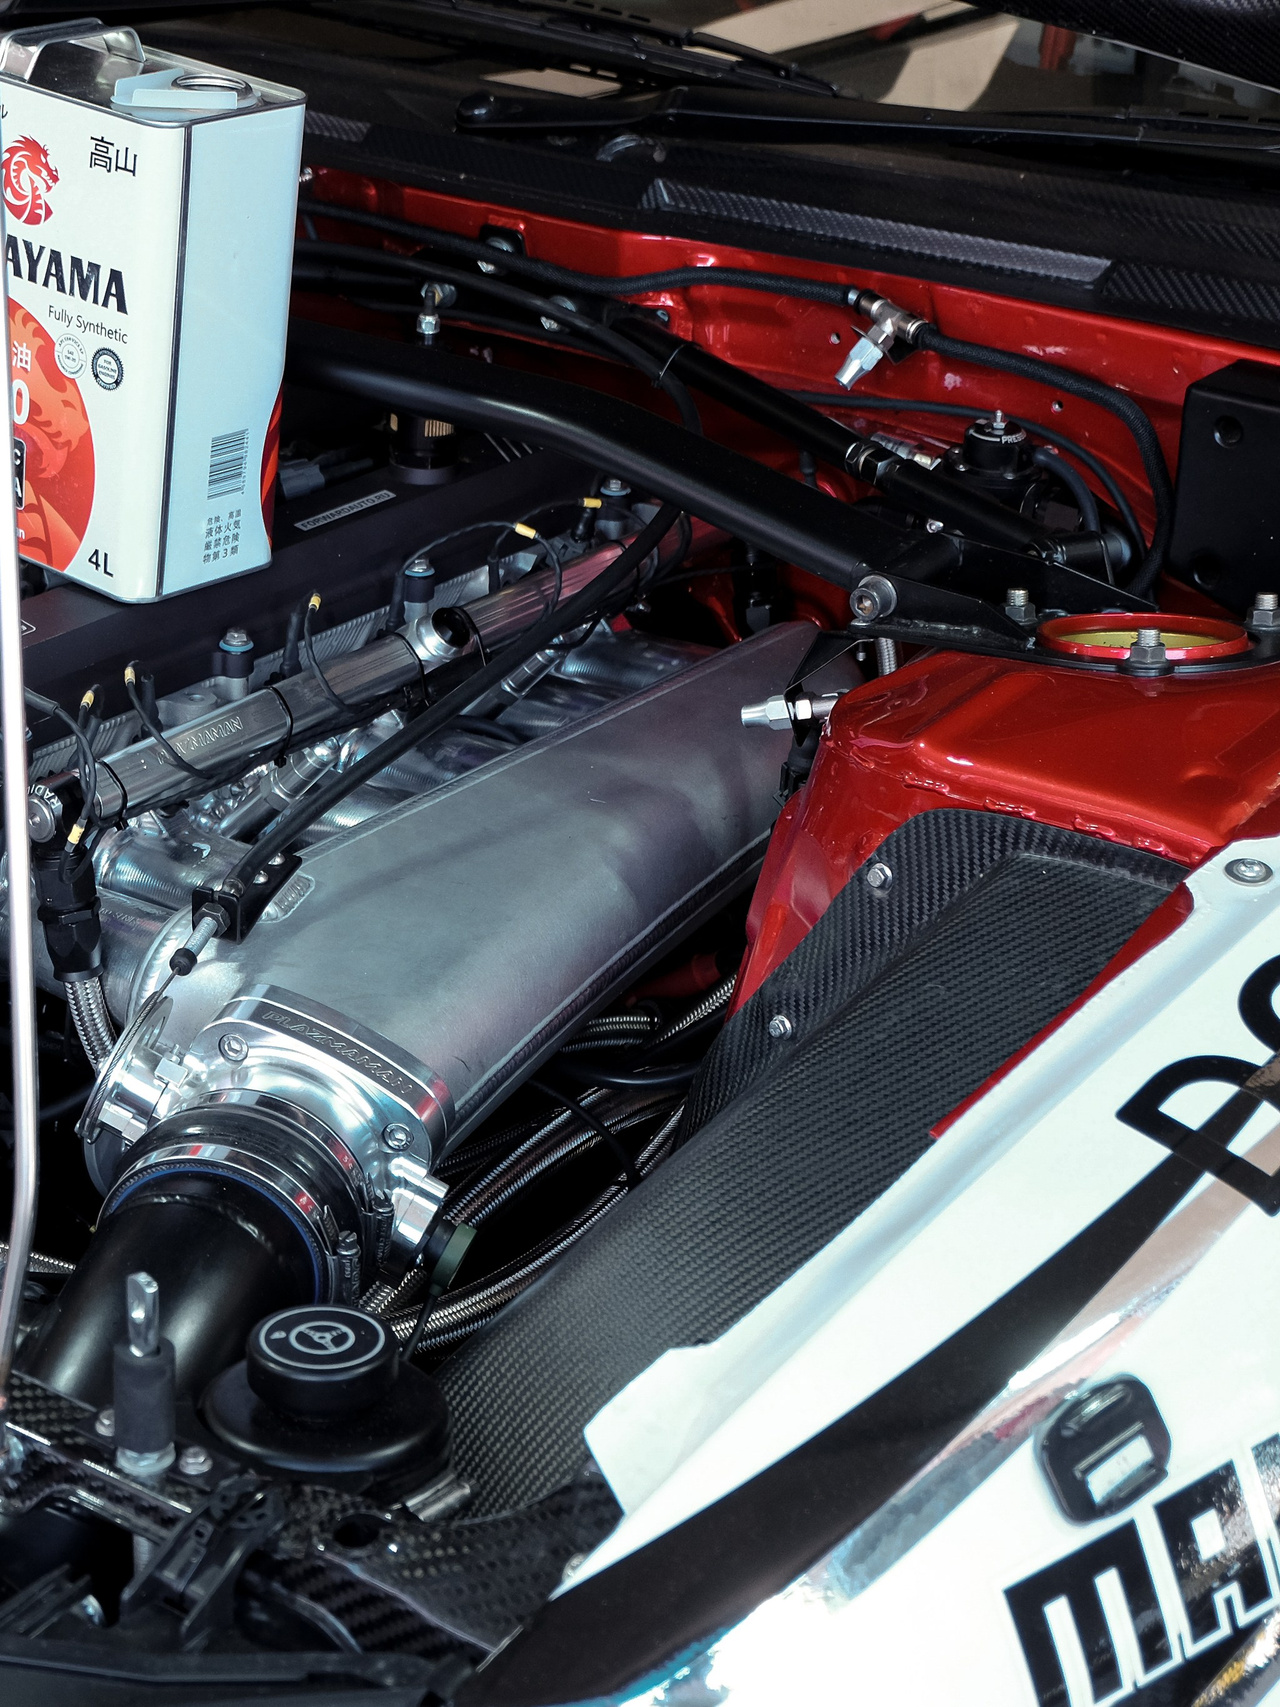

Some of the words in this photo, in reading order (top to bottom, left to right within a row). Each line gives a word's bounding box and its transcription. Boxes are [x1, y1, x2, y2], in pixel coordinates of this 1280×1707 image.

[89, 135, 137, 176] 高山
[48, 304, 74, 329] Fully
[76, 314, 129, 344] Synthetic
[87, 548, 114, 578] 4L
[261, 1010, 414, 1095] PLAZMAMAN
